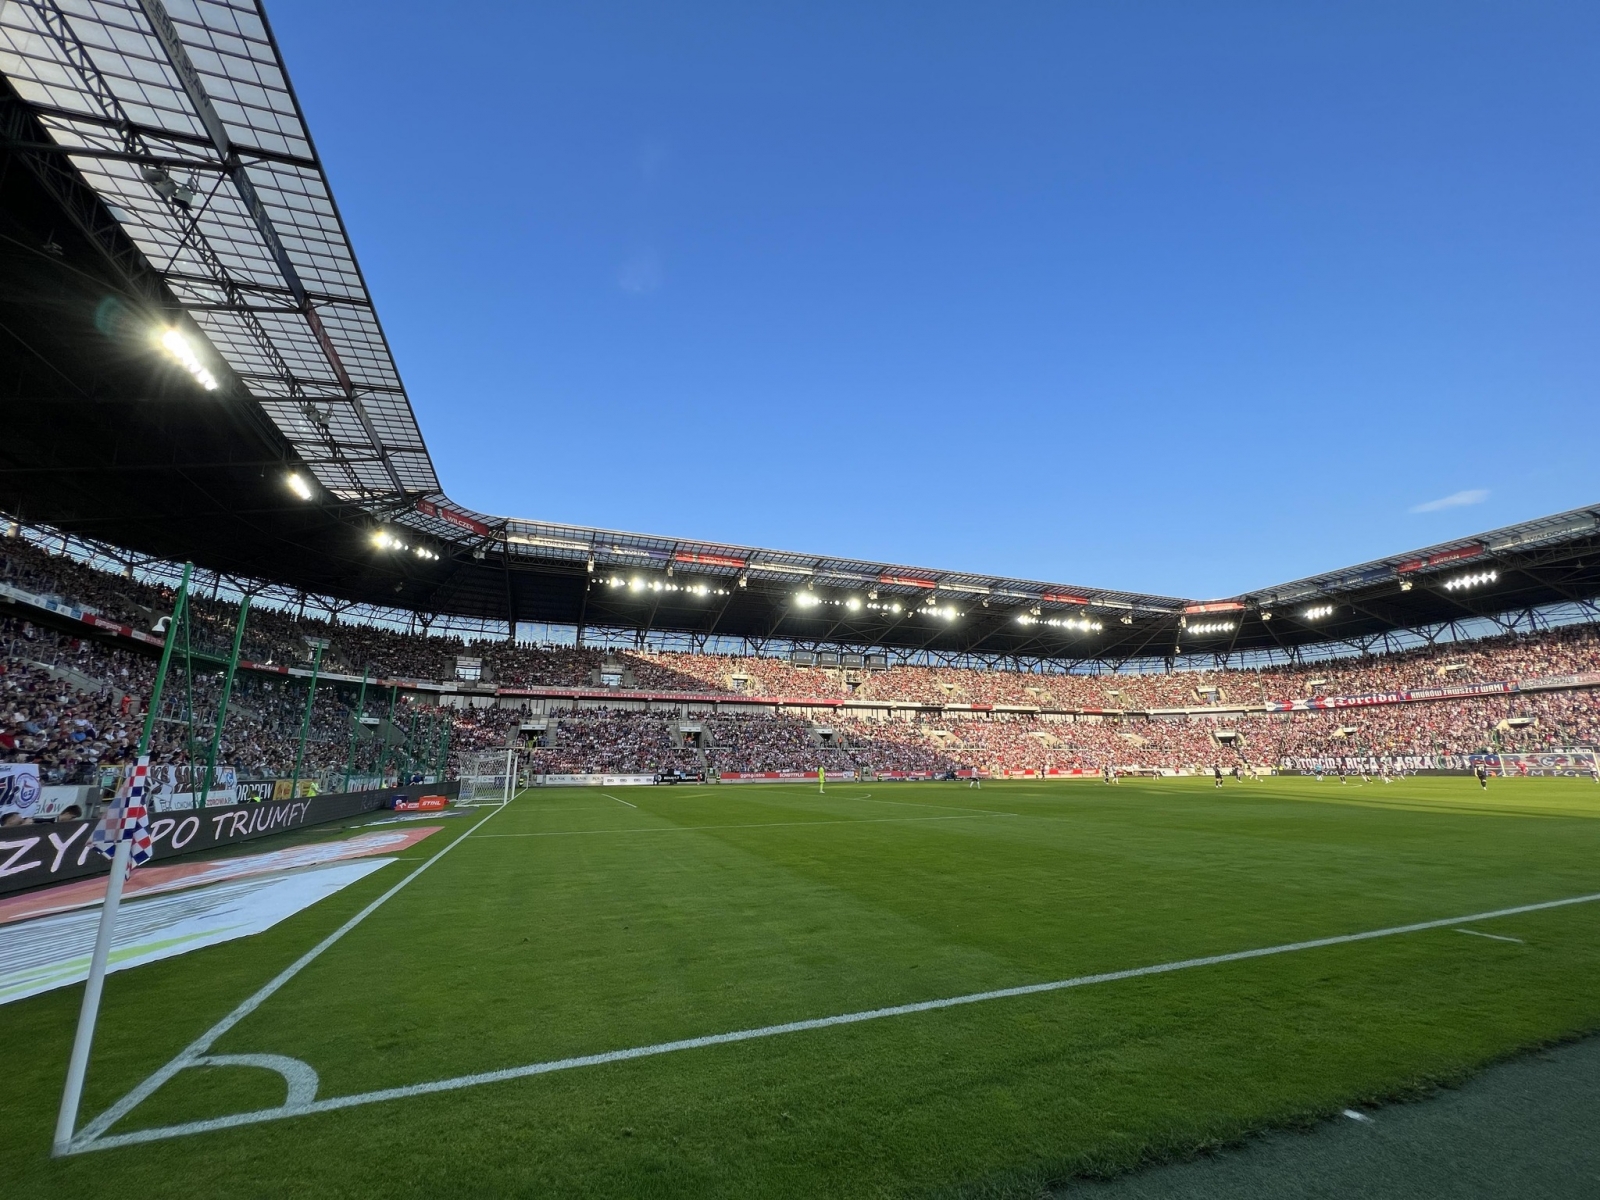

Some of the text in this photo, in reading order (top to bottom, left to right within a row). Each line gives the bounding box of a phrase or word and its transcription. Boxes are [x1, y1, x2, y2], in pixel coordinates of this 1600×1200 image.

[446, 515, 475, 531] WILCZEK
[1443, 687, 1475, 696] ZAWSZE
[1480, 684, 1504, 693] WAMI
[1335, 693, 1398, 706] Torcida
[1345, 757, 1379, 769] RUA
[150, 816, 200, 849] PO
[212, 798, 312, 841] TRIUMFY
